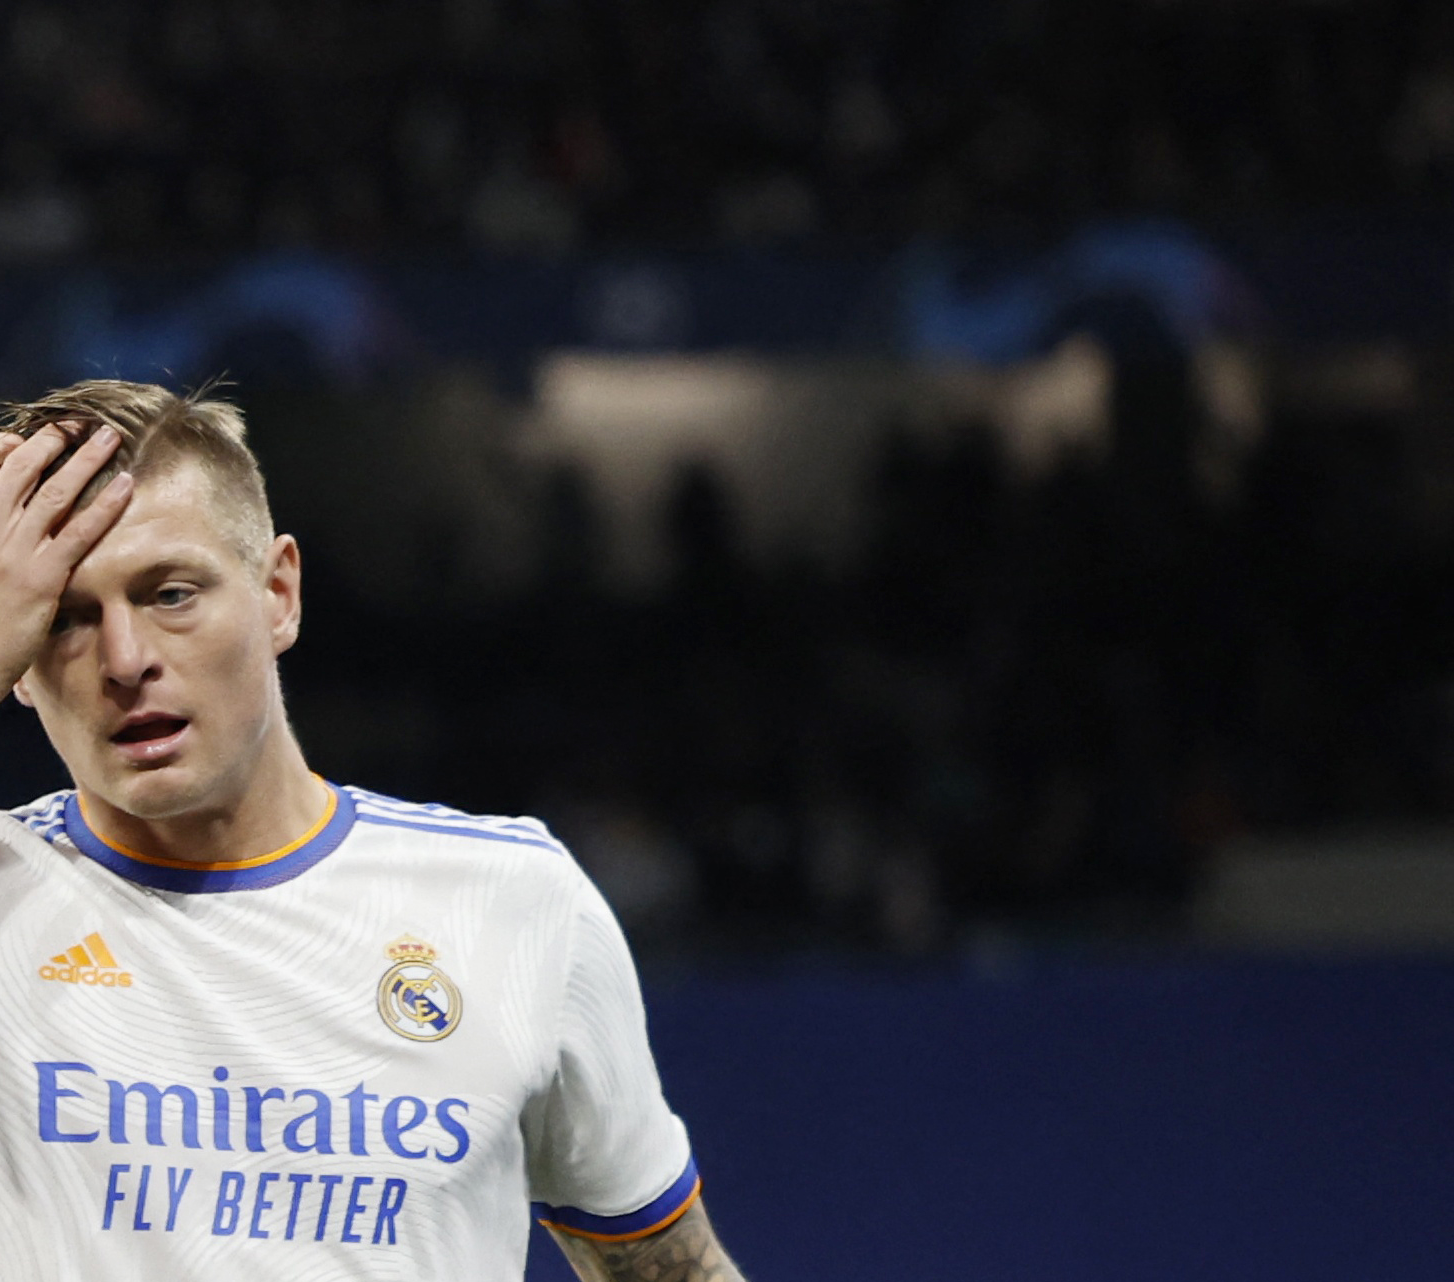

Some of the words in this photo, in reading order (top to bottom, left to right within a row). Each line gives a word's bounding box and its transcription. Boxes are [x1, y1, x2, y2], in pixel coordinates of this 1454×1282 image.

[39, 963, 133, 988] adidas
[31, 1060, 471, 1164] Emirates
[102, 1164, 193, 1232] FLY
[211, 1171, 408, 1246] BETTER
